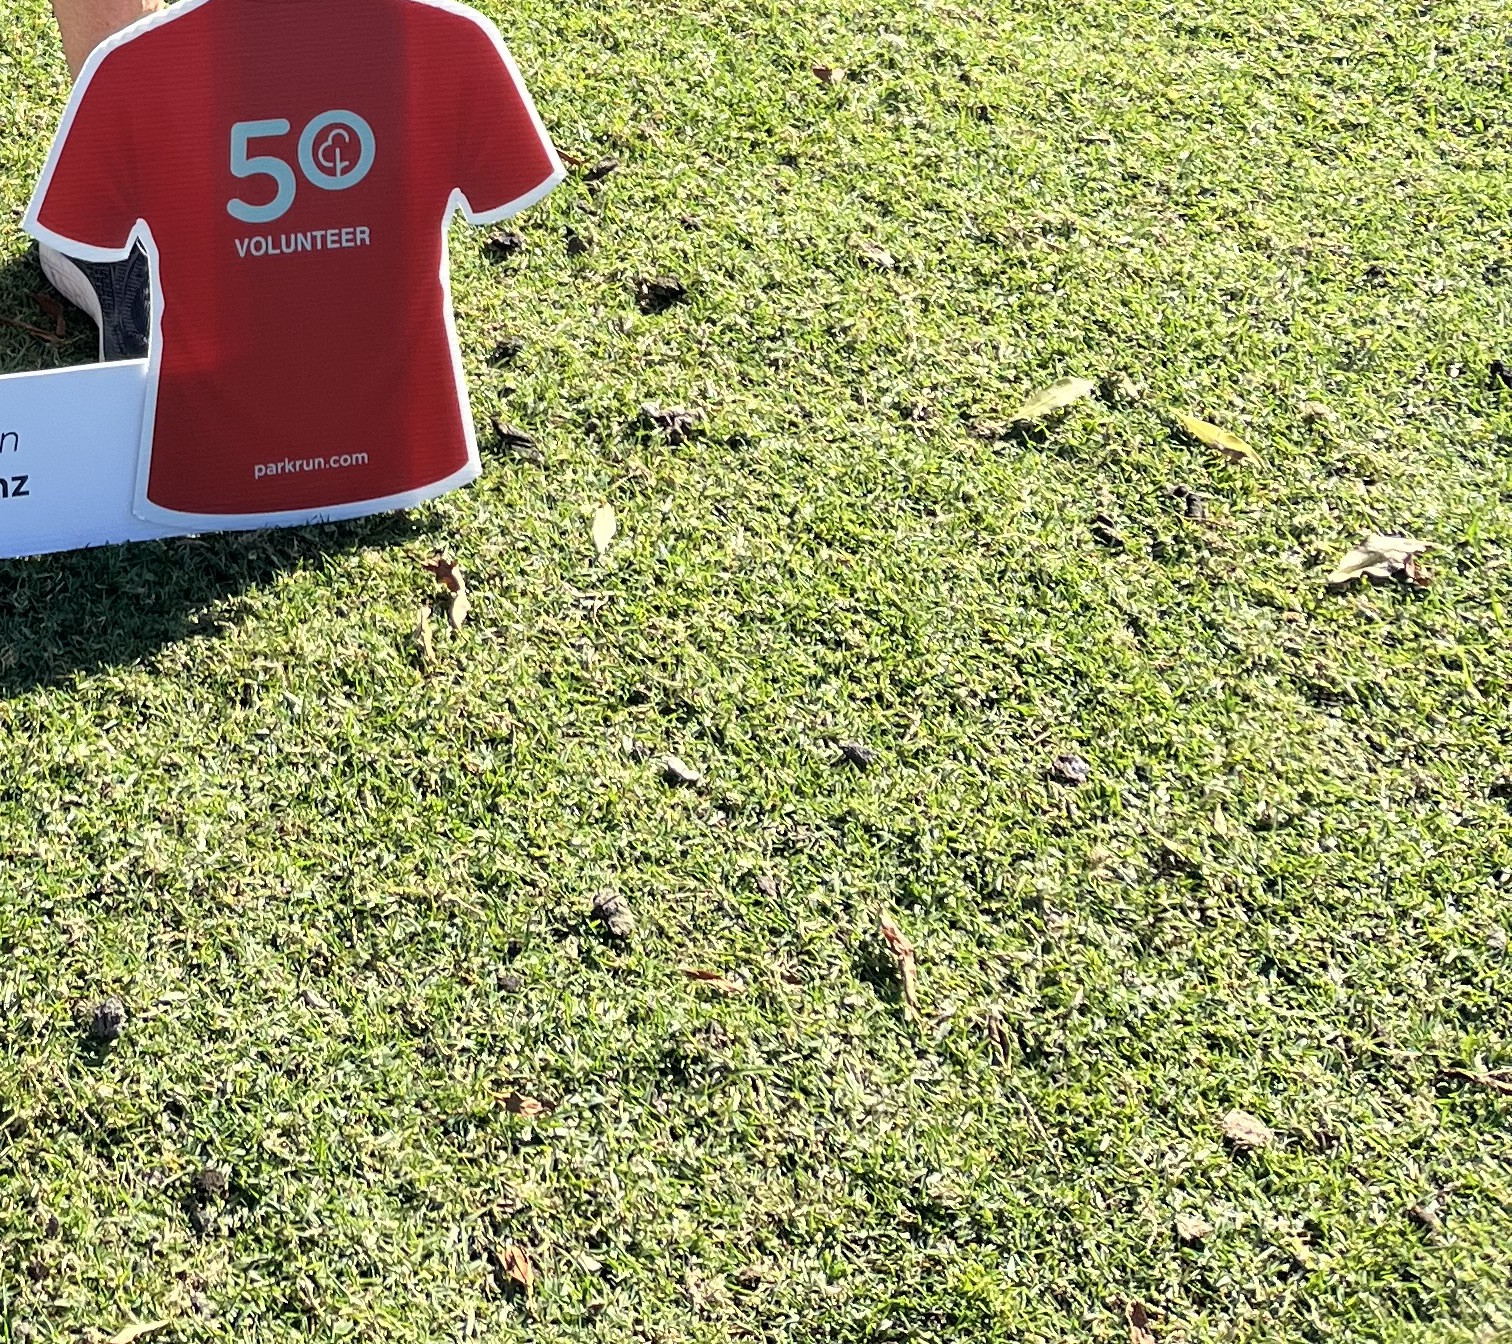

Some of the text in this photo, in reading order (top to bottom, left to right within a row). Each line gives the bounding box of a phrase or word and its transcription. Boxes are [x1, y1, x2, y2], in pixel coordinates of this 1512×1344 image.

[226, 109, 376, 223] 50
[234, 225, 371, 258] VOLUNTEER
[253, 451, 369, 480] parkrun.com
